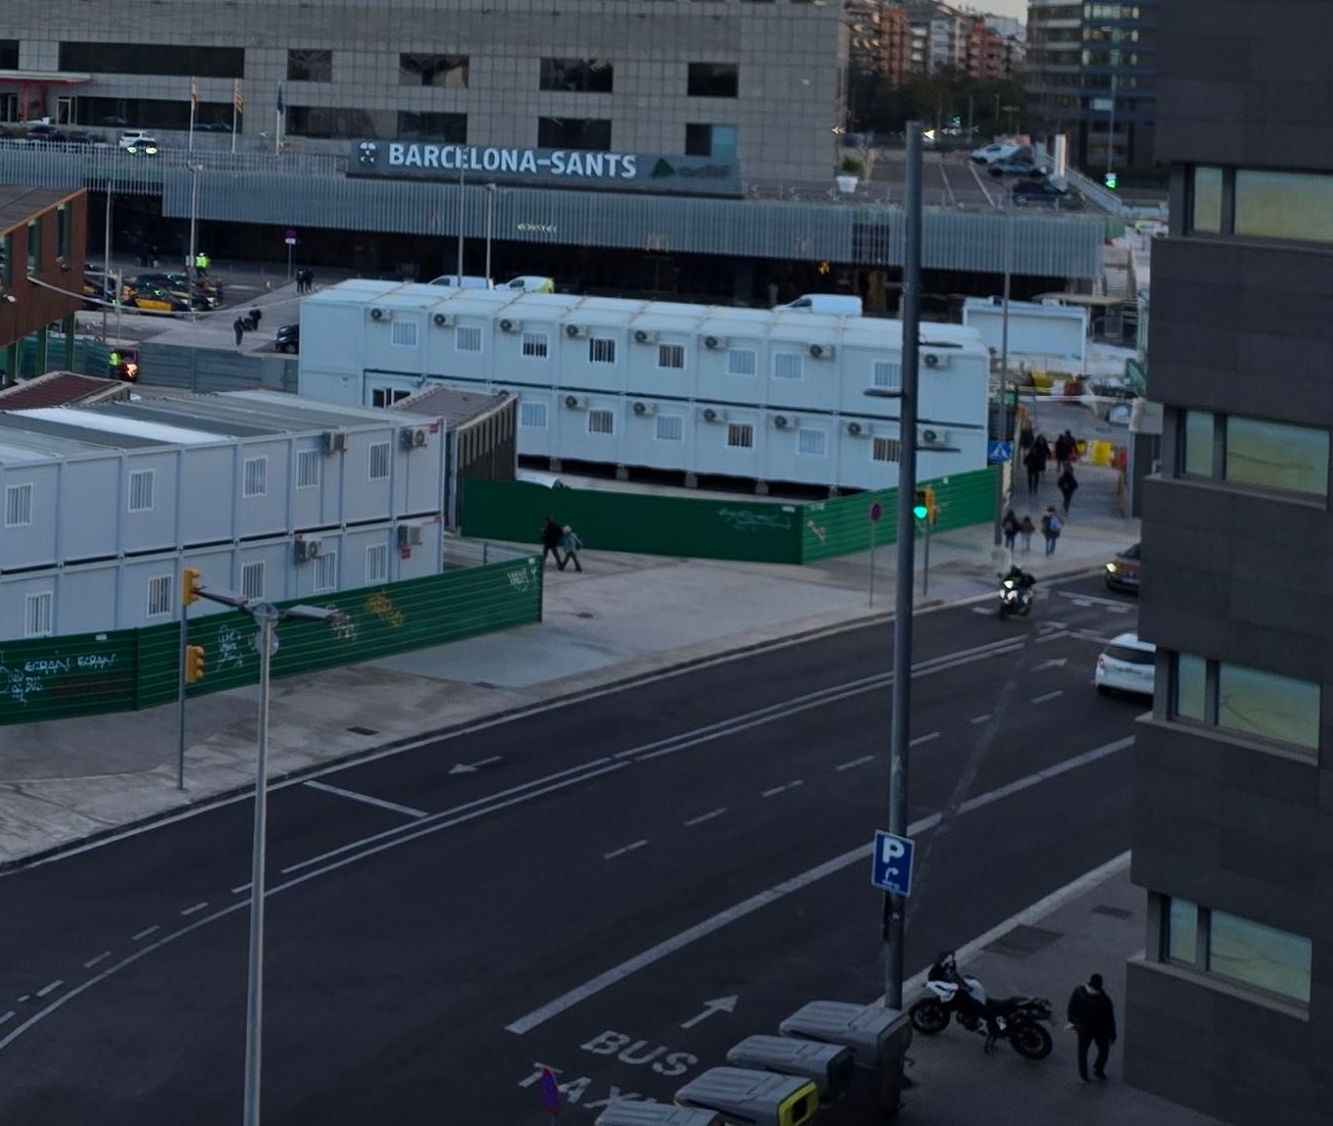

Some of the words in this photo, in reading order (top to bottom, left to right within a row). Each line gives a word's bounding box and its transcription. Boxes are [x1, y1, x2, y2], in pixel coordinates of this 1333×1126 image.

[388, 142, 637, 179] BARCELONA-SANTS
[882, 837, 905, 864] P
[580, 1029, 699, 1076] BUS
[517, 1061, 657, 1109] TAX
